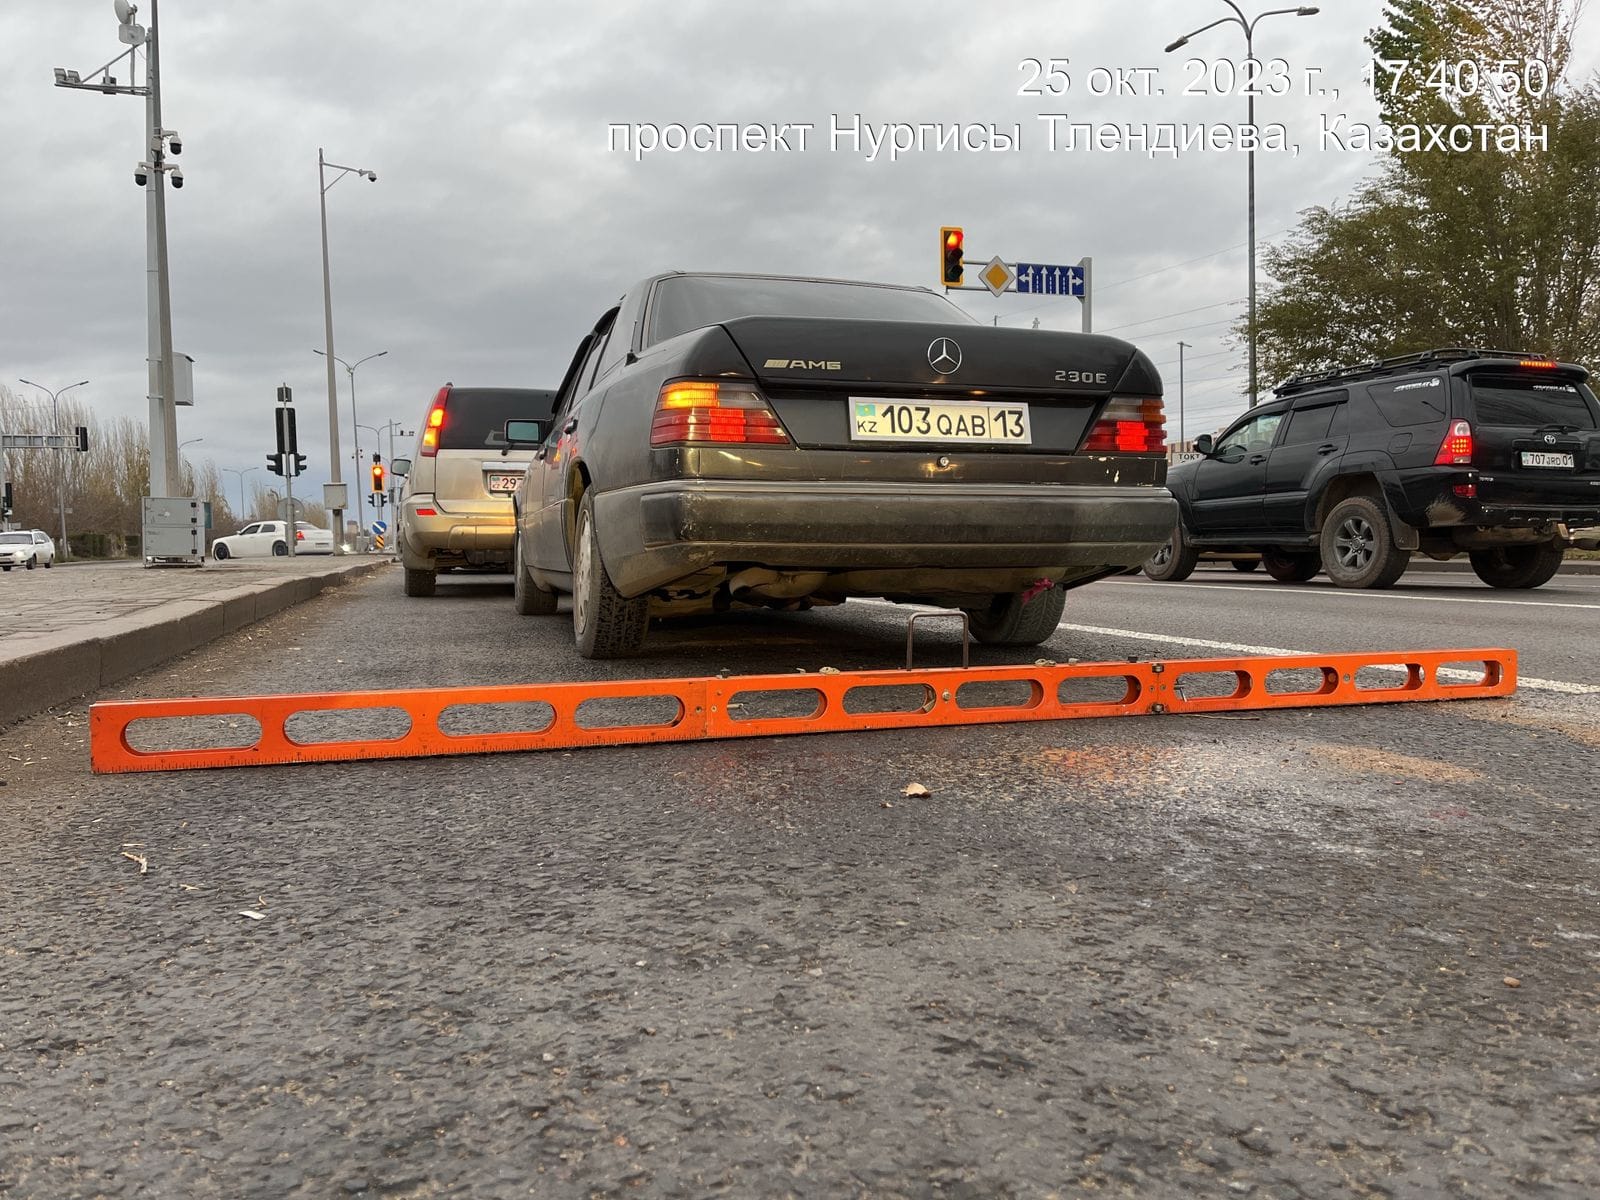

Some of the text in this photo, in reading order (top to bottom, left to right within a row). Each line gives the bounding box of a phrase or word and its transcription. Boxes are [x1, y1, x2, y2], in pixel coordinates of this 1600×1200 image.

[789, 360, 841, 370] AMG
[1055, 370, 1107, 384] 230E
[857, 421, 877, 433] KZ
[881, 405, 1024, 438] 103 QAB 13
[1530, 453, 1545, 464] 707
